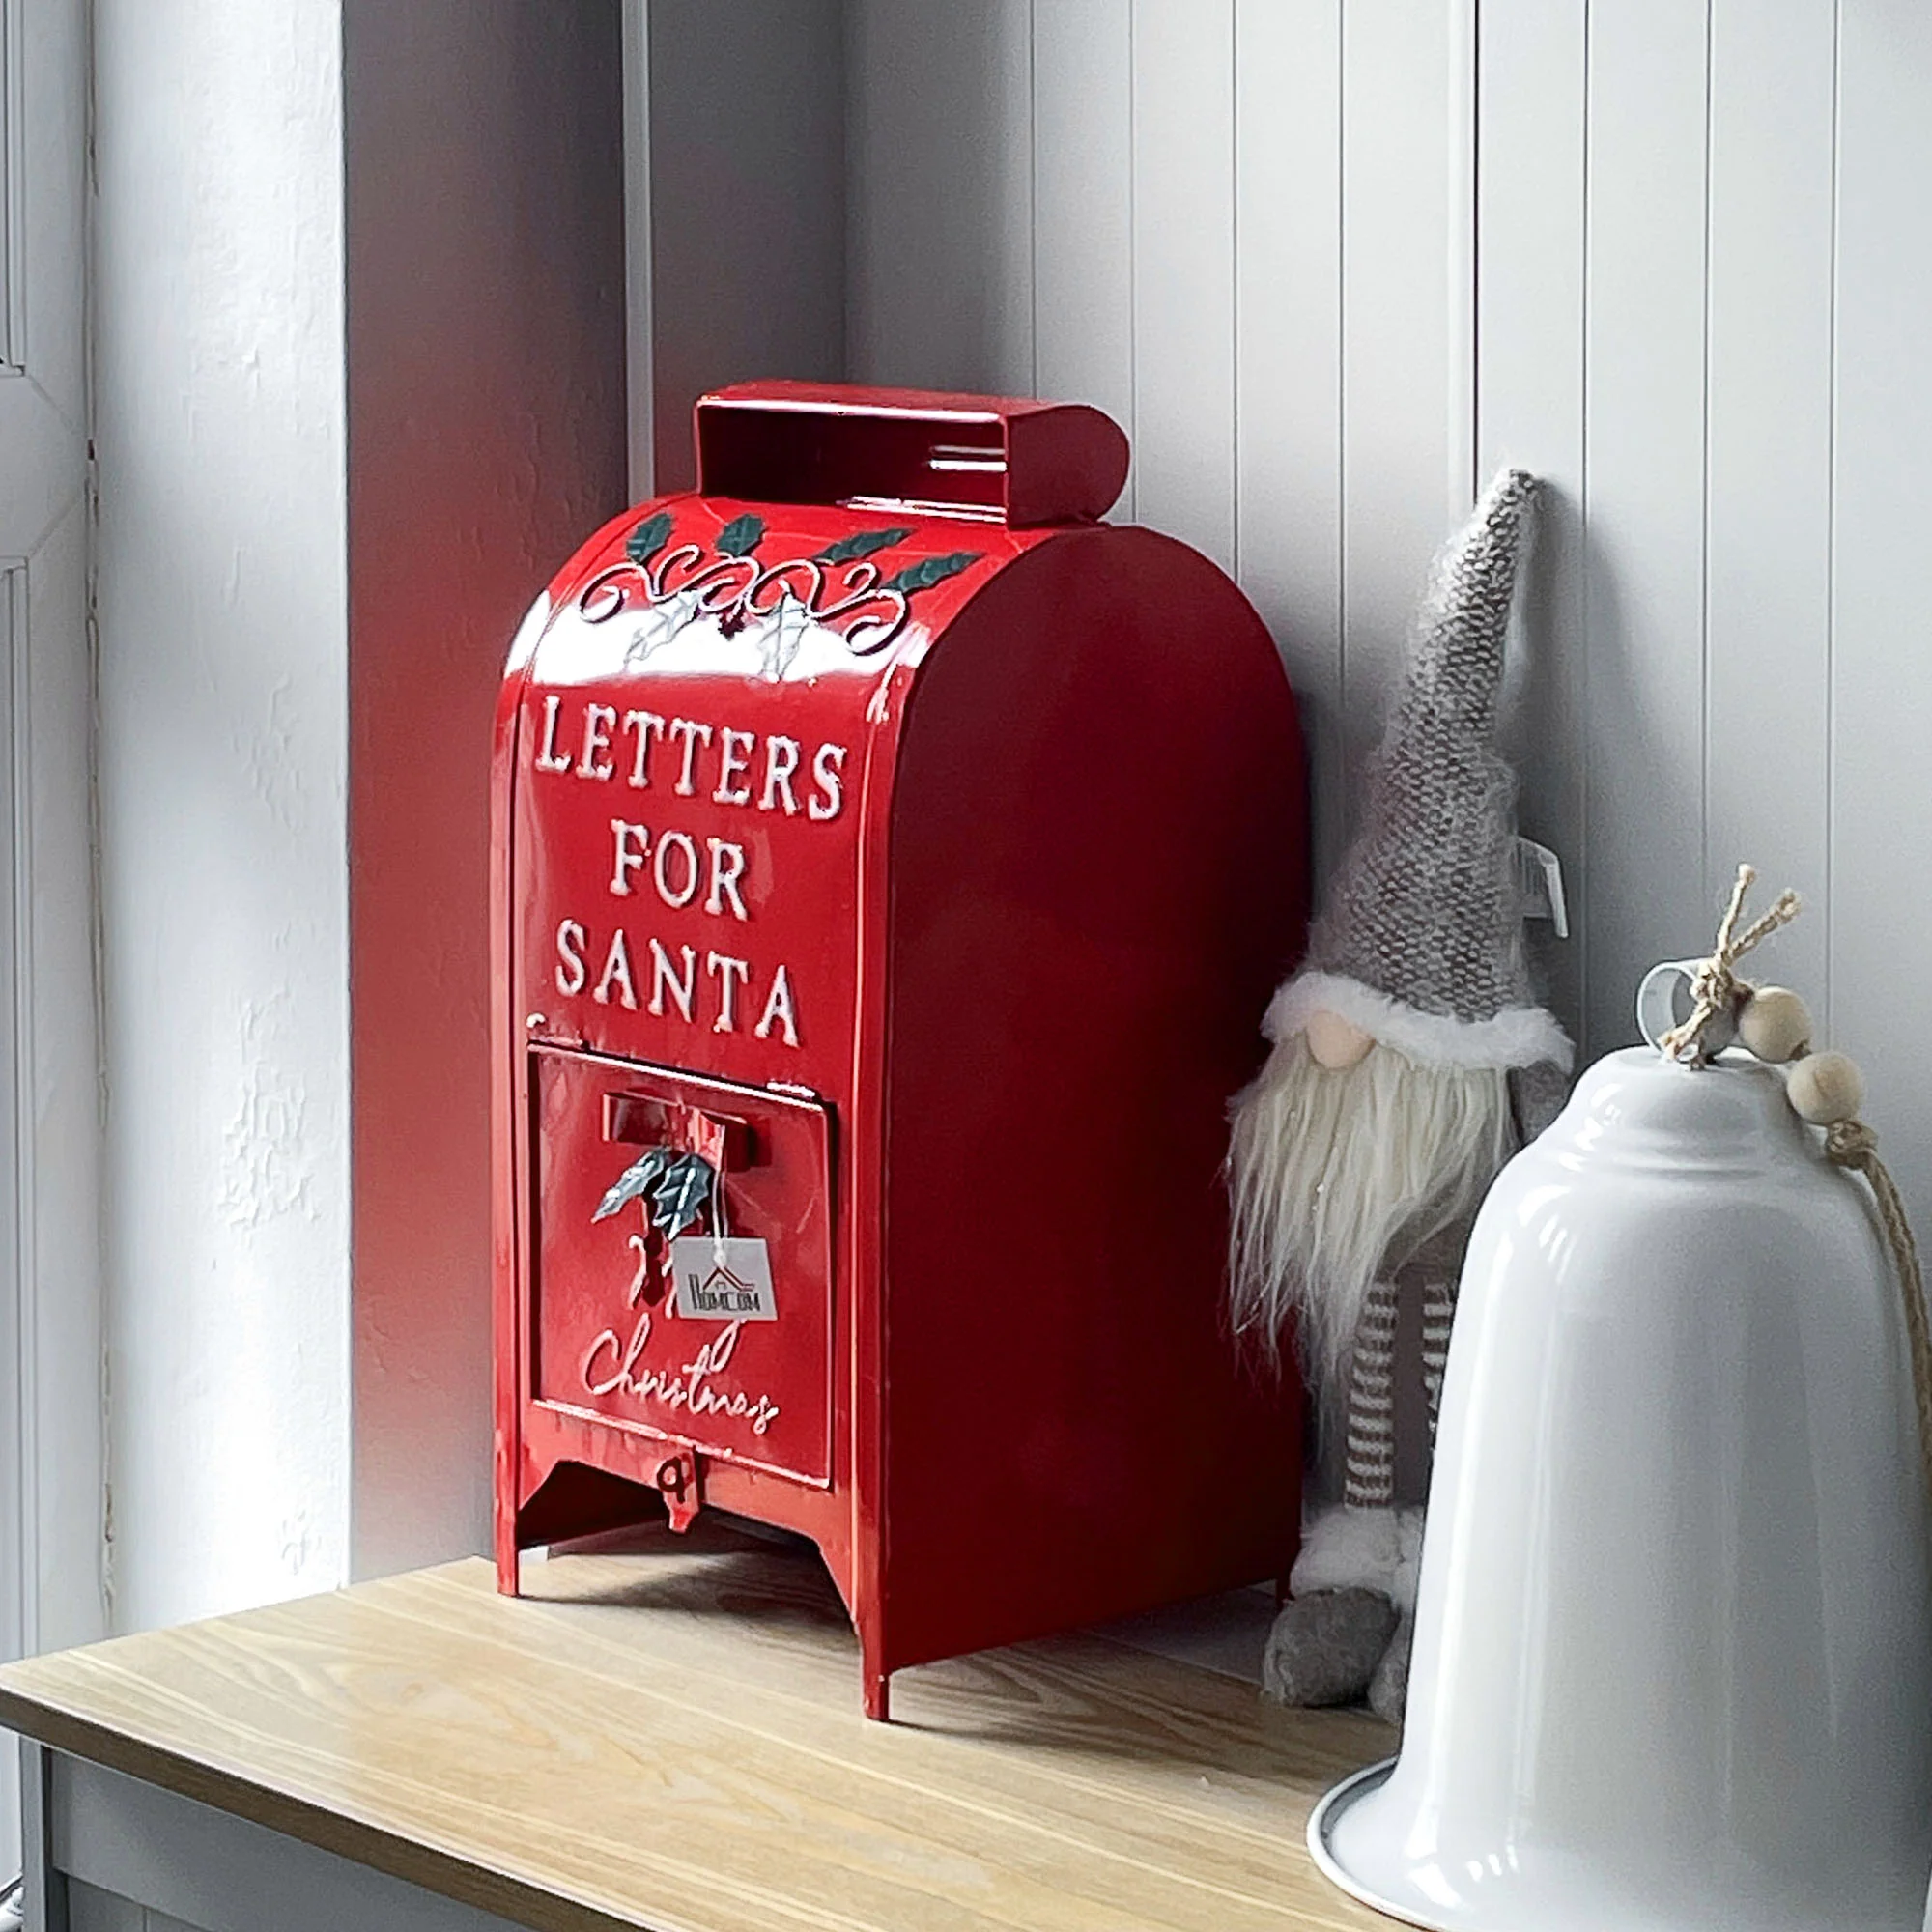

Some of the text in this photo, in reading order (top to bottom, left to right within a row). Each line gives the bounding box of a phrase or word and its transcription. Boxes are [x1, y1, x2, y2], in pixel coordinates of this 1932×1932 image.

[536, 696, 847, 820] LETTERS
[610, 818, 749, 922] FOR
[554, 919, 800, 1049] SANTA
[582, 1313, 779, 1435] Christmas
